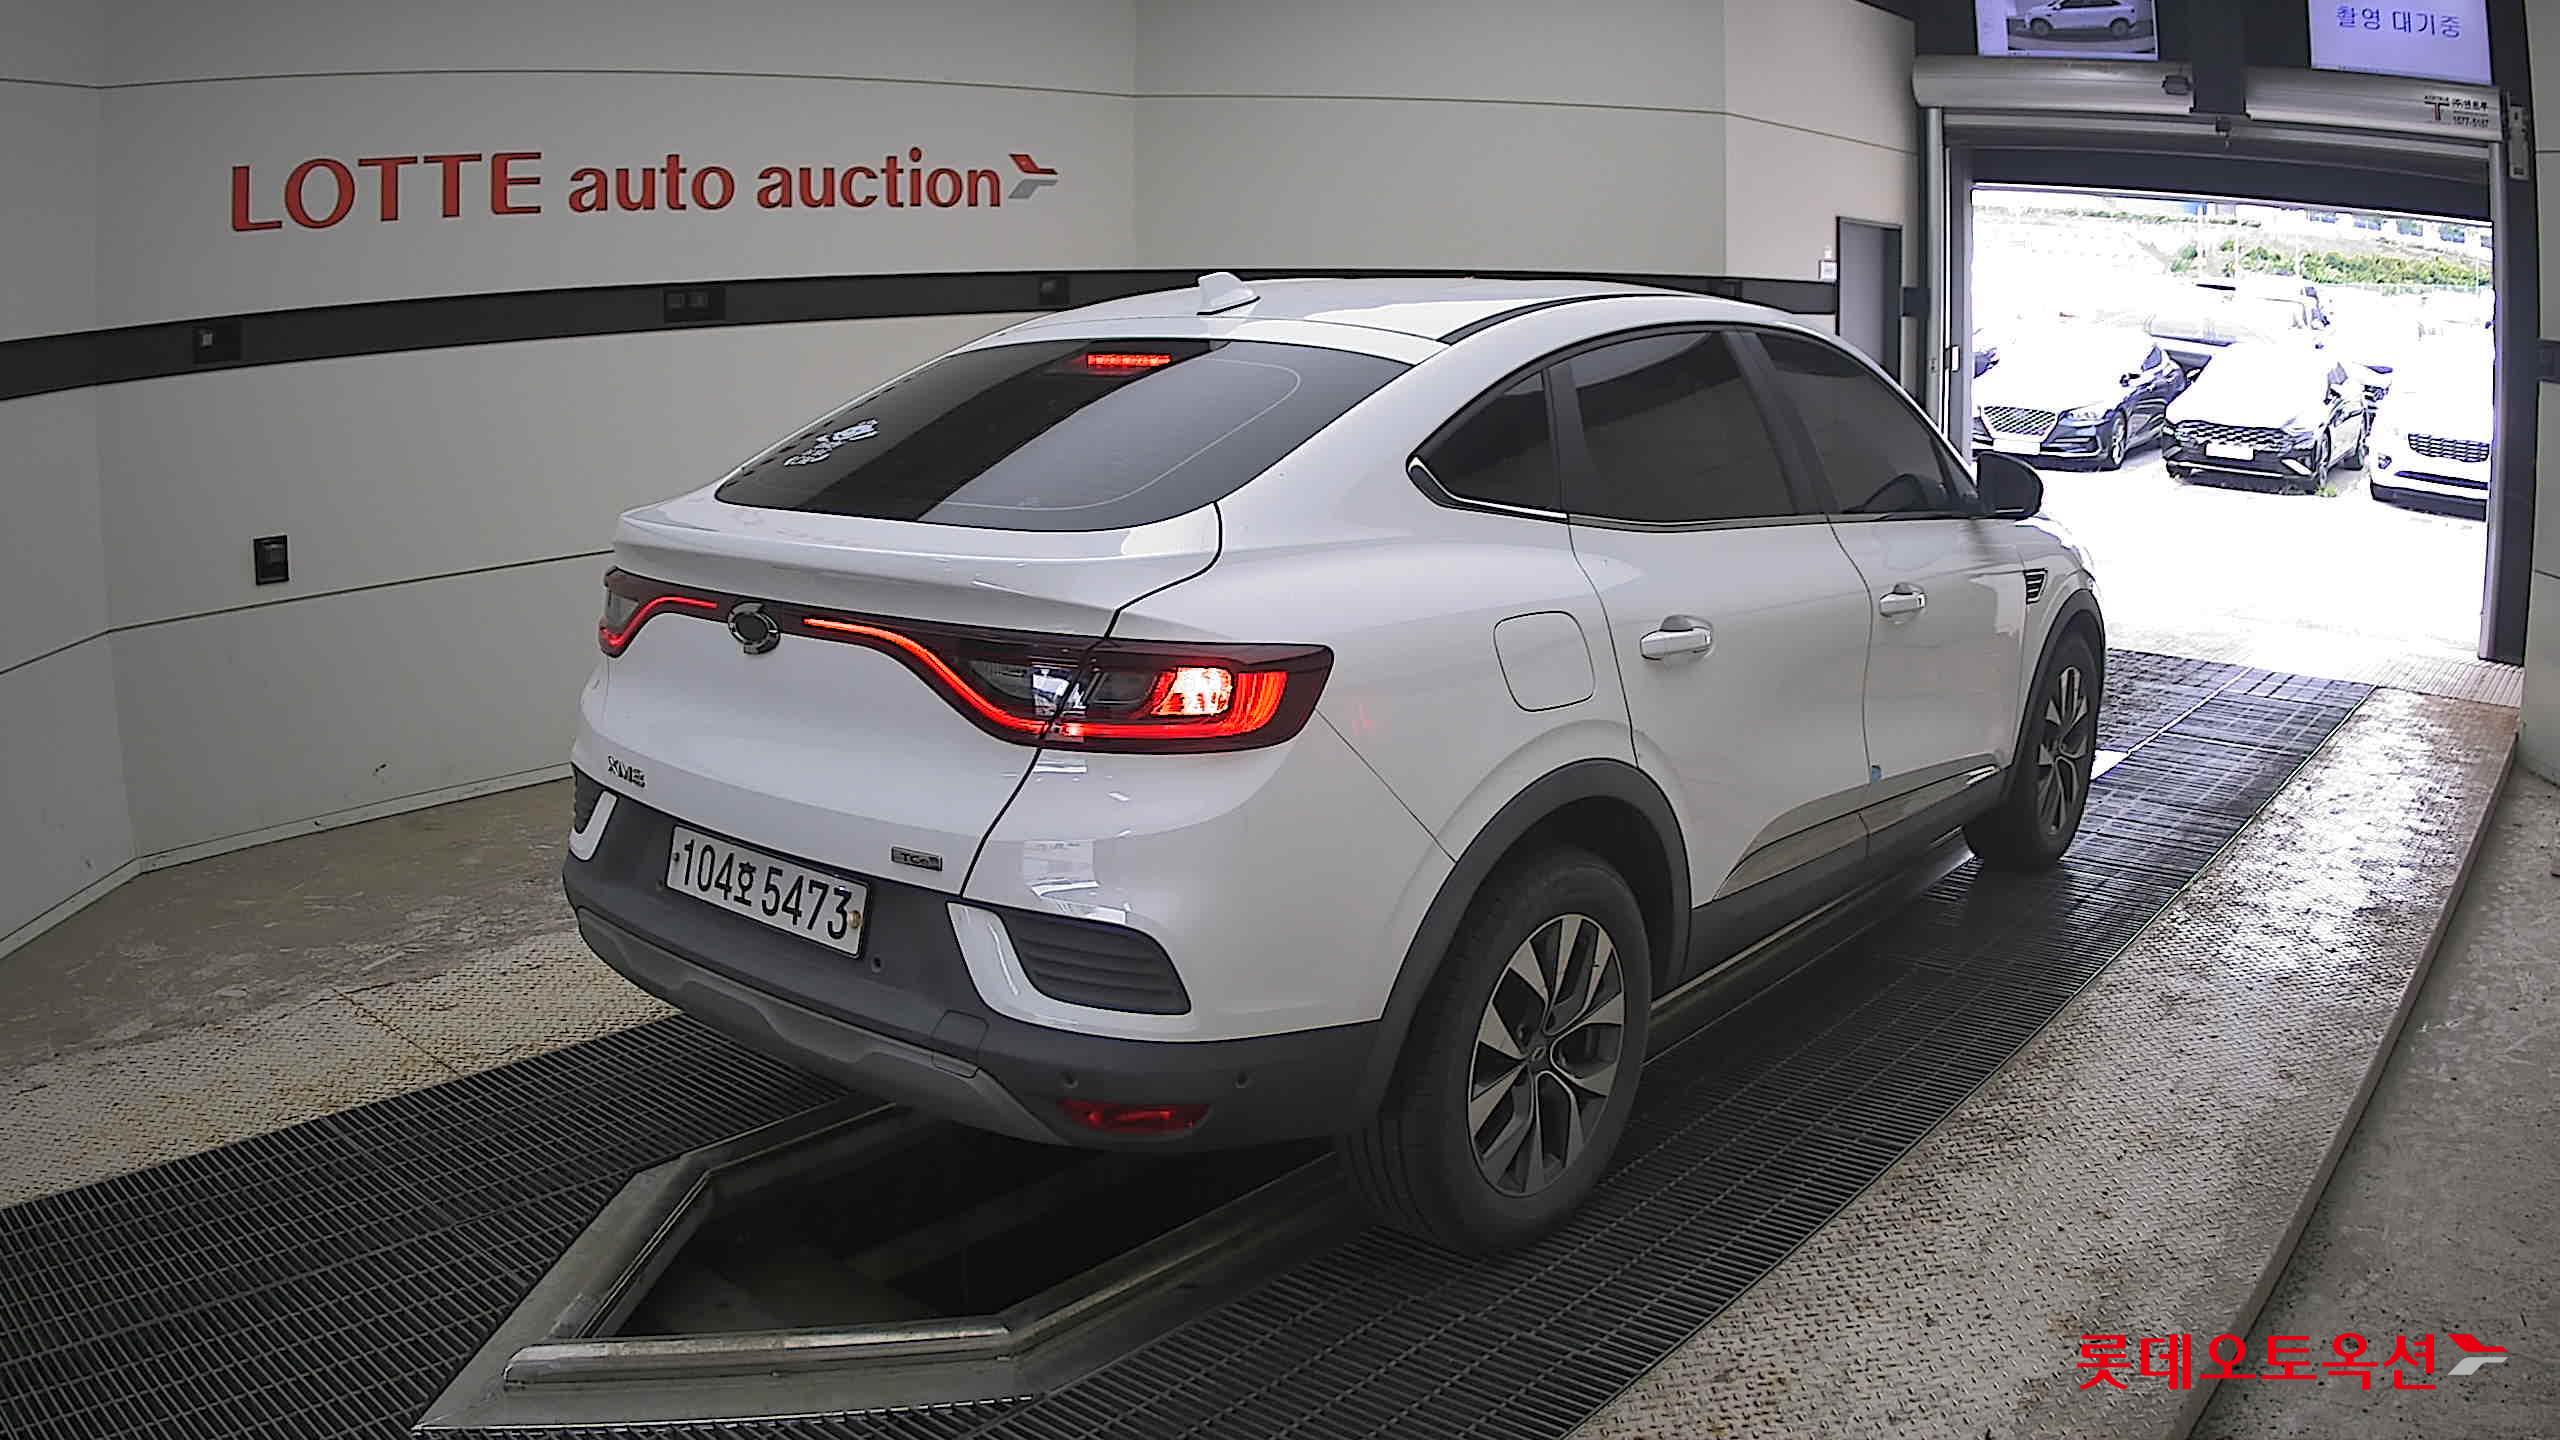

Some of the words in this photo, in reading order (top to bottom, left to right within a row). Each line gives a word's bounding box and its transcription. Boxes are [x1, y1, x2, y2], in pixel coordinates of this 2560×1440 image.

[2336, 6, 2381, 30] 촬영
[2392, 10, 2462, 39] 대기중
[232, 151, 542, 232] LOTTE
[568, 153, 735, 213] auto
[756, 147, 1001, 209] auction
